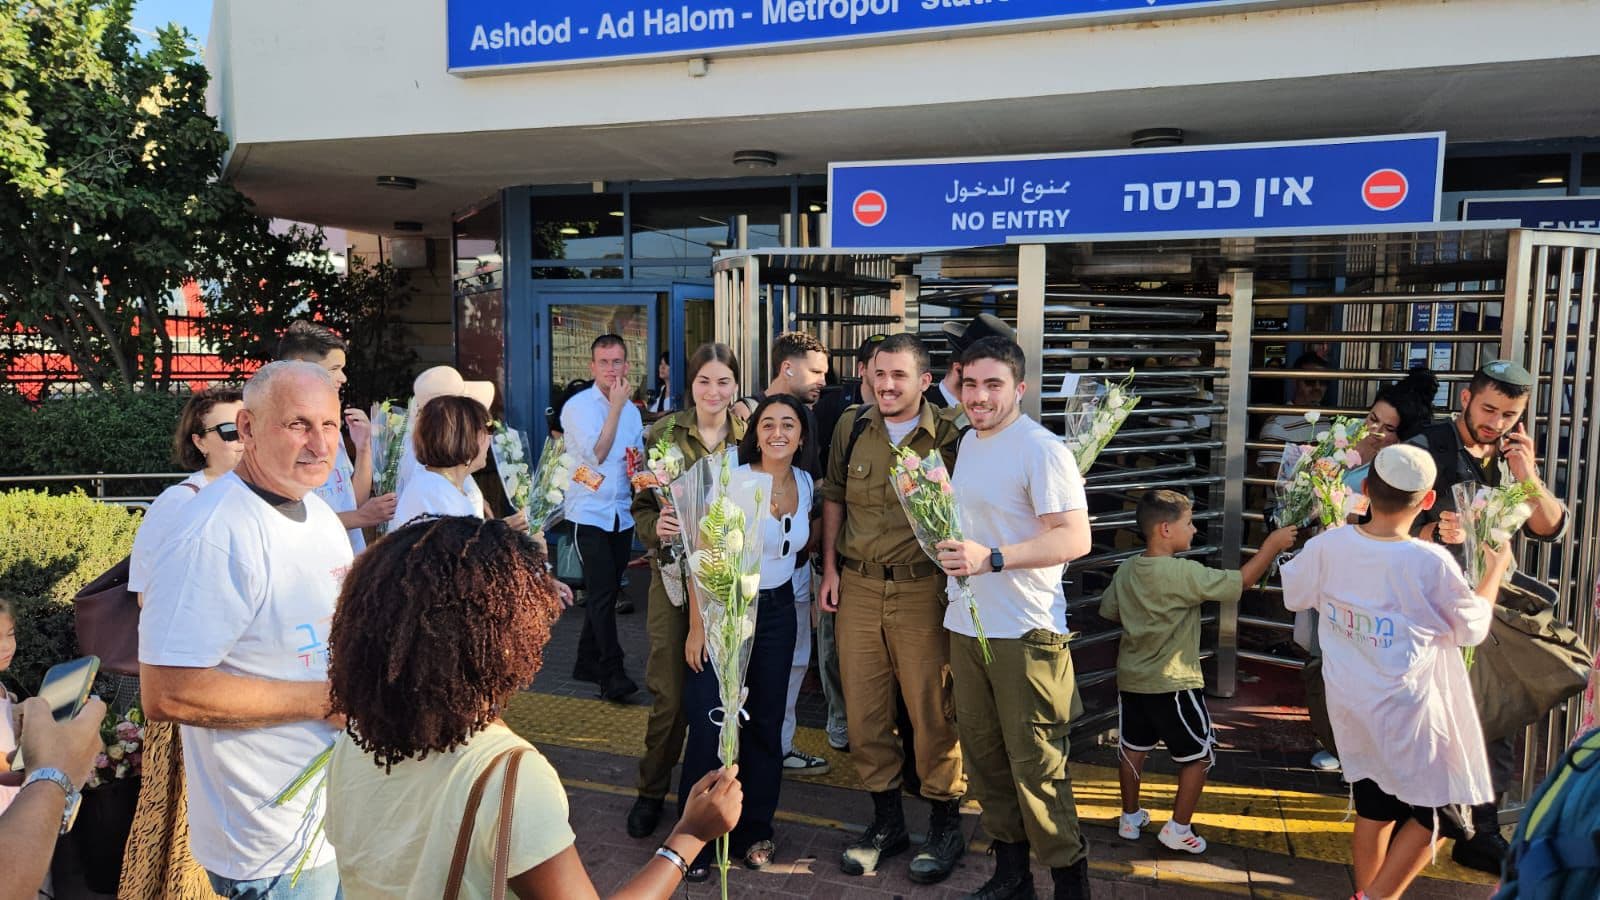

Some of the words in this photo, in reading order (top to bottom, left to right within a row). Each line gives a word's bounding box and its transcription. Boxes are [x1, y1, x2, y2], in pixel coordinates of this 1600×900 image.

[469, 17, 571, 50] Ashdod
[597, 11, 634, 39] Ad
[643, 6, 734, 35] Halom
[945, 177, 1015, 203] الدخول
[1021, 180, 1071, 203] ممنوع
[1123, 179, 1241, 212] כניסה
[1254, 176, 1314, 217] אין
[951, 211, 985, 231] NO
[992, 208, 1071, 229] ENTRY
[1327, 602, 1394, 637] מתנדב
